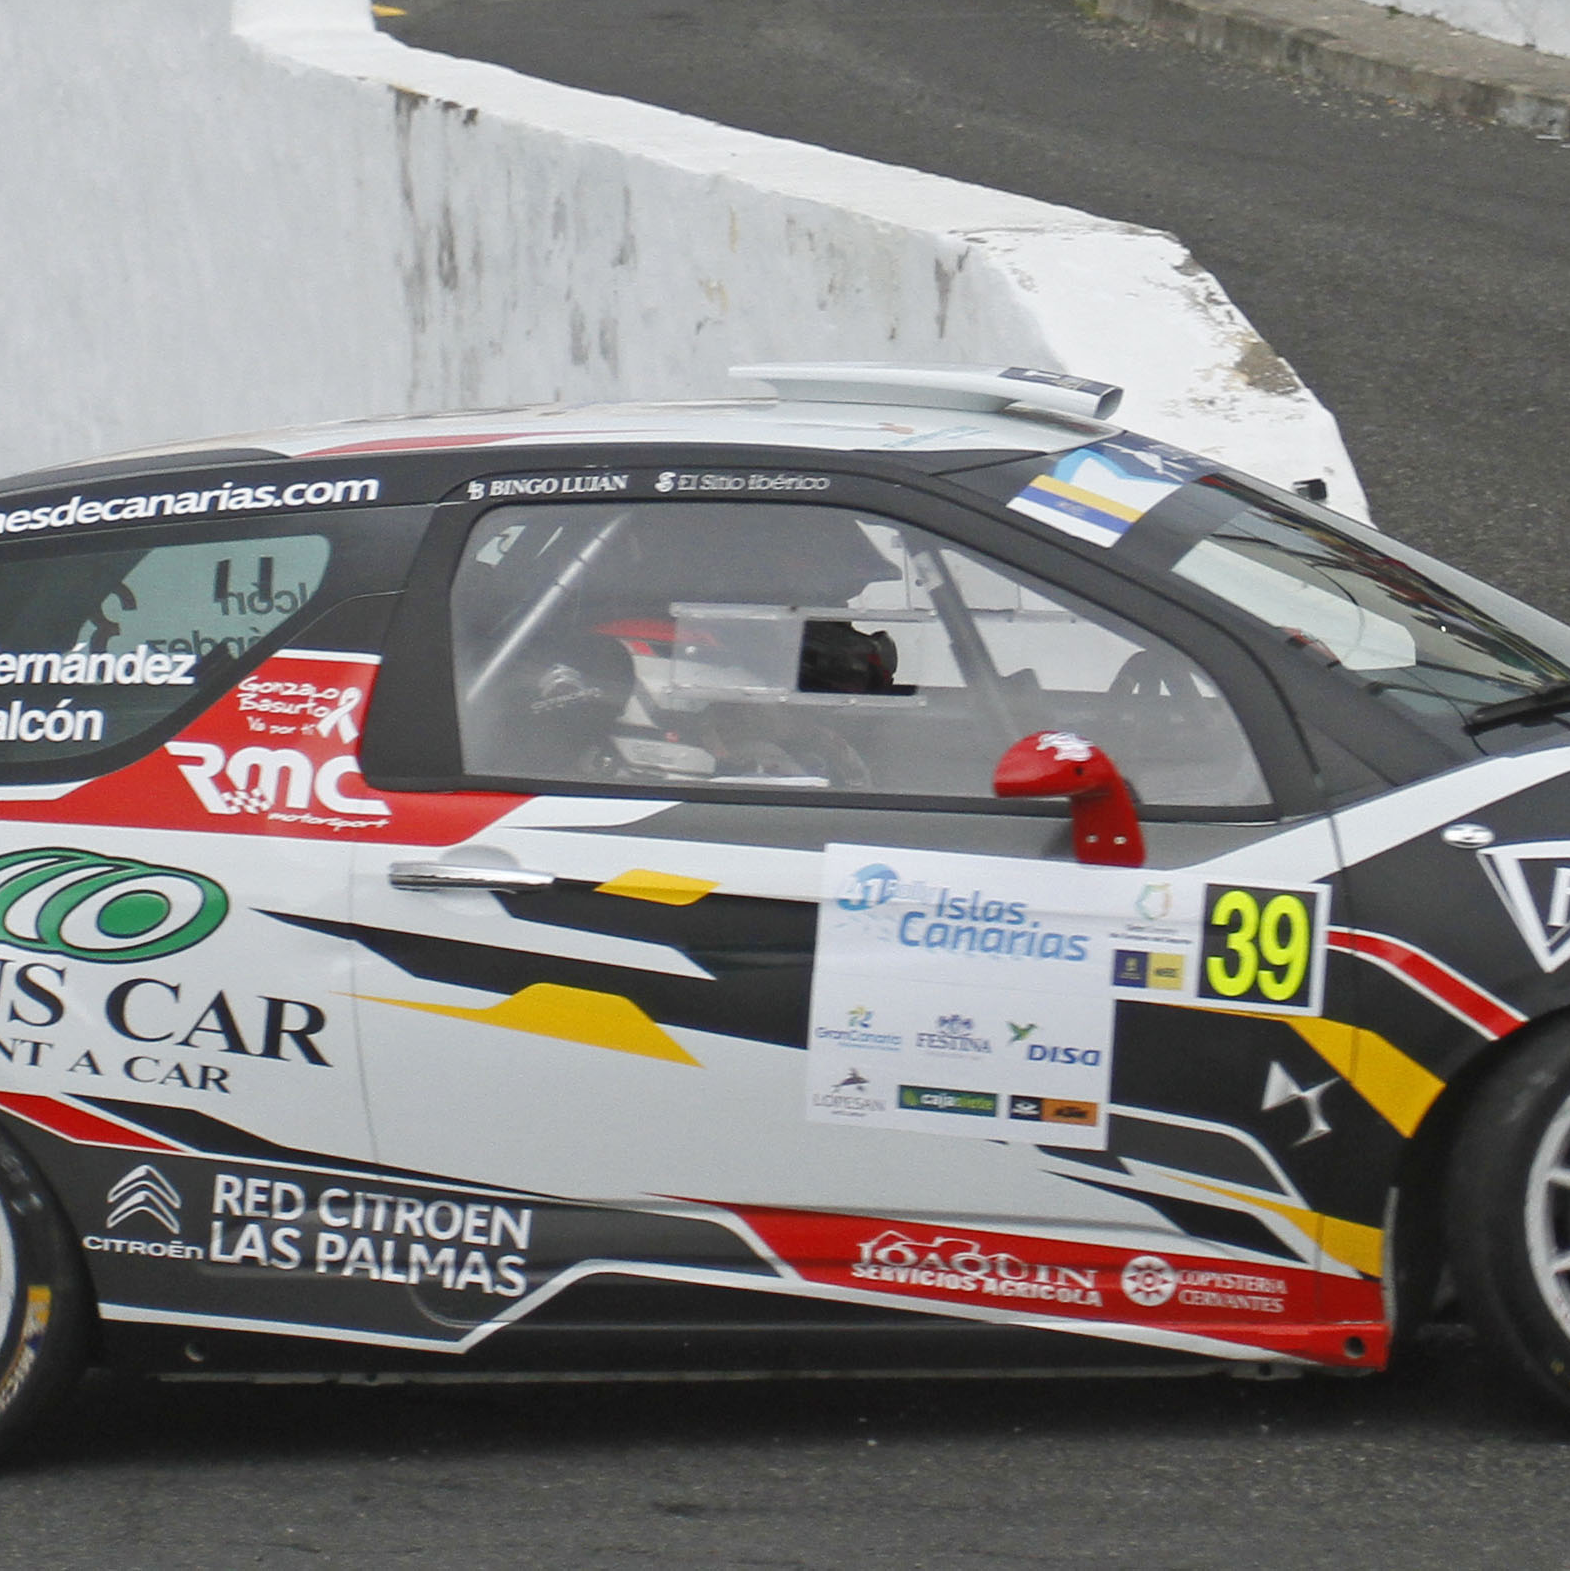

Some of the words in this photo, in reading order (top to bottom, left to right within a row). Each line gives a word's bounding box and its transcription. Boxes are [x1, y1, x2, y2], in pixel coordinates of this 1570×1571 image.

[489, 476, 559, 496] BINGO
[236, 693, 330, 718] Basurto
[937, 887, 1027, 925] Islas
[898, 910, 1092, 961] Canarias
[1206, 890, 1310, 1001] 39
[105, 977, 334, 1068] CAR
[916, 1032, 993, 1054] FESTINA
[67, 1050, 104, 1077] A
[123, 1055, 232, 1094] CAR
[212, 1174, 306, 1222] RED
[318, 1188, 532, 1249] CITROEN
[209, 1221, 303, 1270] LAS
[315, 1232, 528, 1298] PALMAS
[855, 1238, 1099, 1290] JOAQUIN
[851, 1262, 977, 1292] SERVICIOS
[981, 1278, 1104, 1308] AGRICOLA
[1177, 1289, 1286, 1313] CERVANTES
